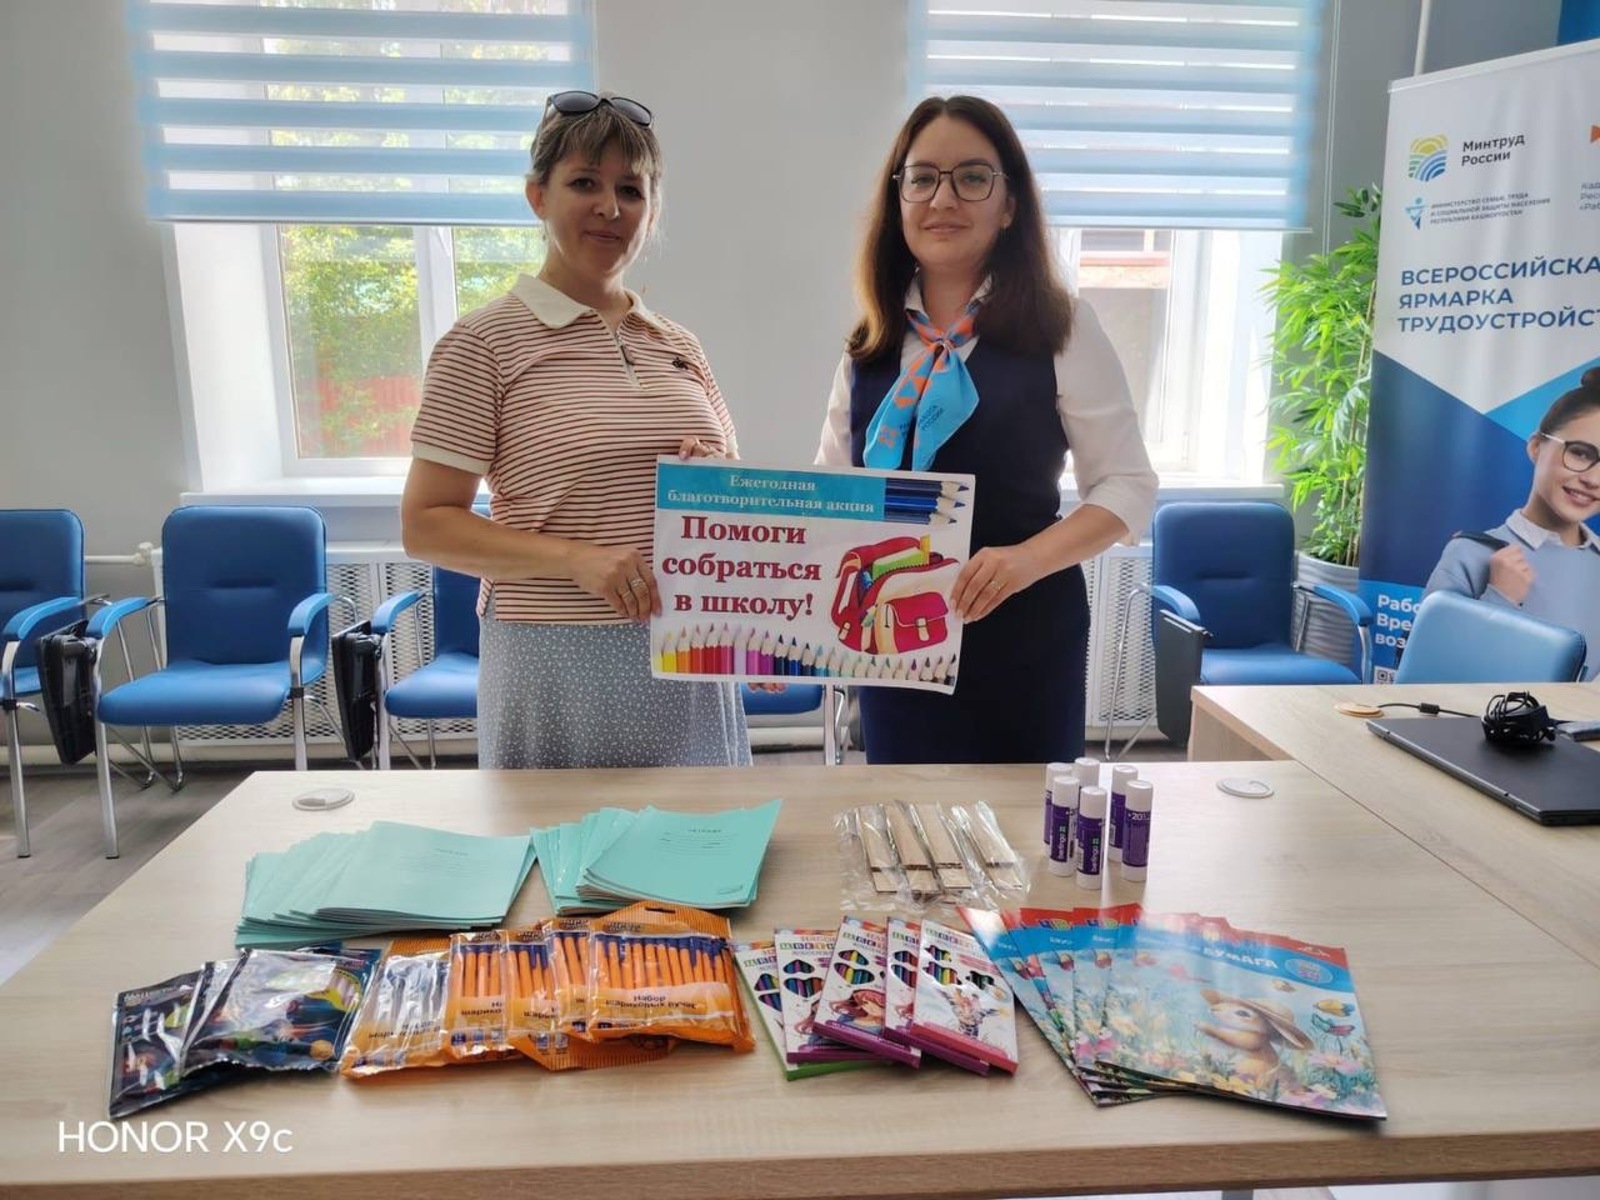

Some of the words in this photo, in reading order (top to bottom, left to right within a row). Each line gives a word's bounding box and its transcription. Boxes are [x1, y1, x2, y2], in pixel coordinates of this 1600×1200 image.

[1462, 134, 1525, 152] Минтруд
[1461, 150, 1511, 166] России
[1400, 255, 1600, 286] ВСЕРОССИЙСКА
[1399, 288, 1514, 309] ЯРМАРКА
[1397, 305, 1600, 334] ТРУДОУСТРОЙС
[730, 475, 816, 492] Ежегодная
[667, 489, 822, 509] благотворительная
[826, 501, 875, 514] акция
[680, 515, 807, 545] Помоги
[661, 553, 821, 582] собраться
[673, 593, 693, 612] в
[700, 593, 813, 621] школу!
[1376, 612, 1412, 632] Вре
